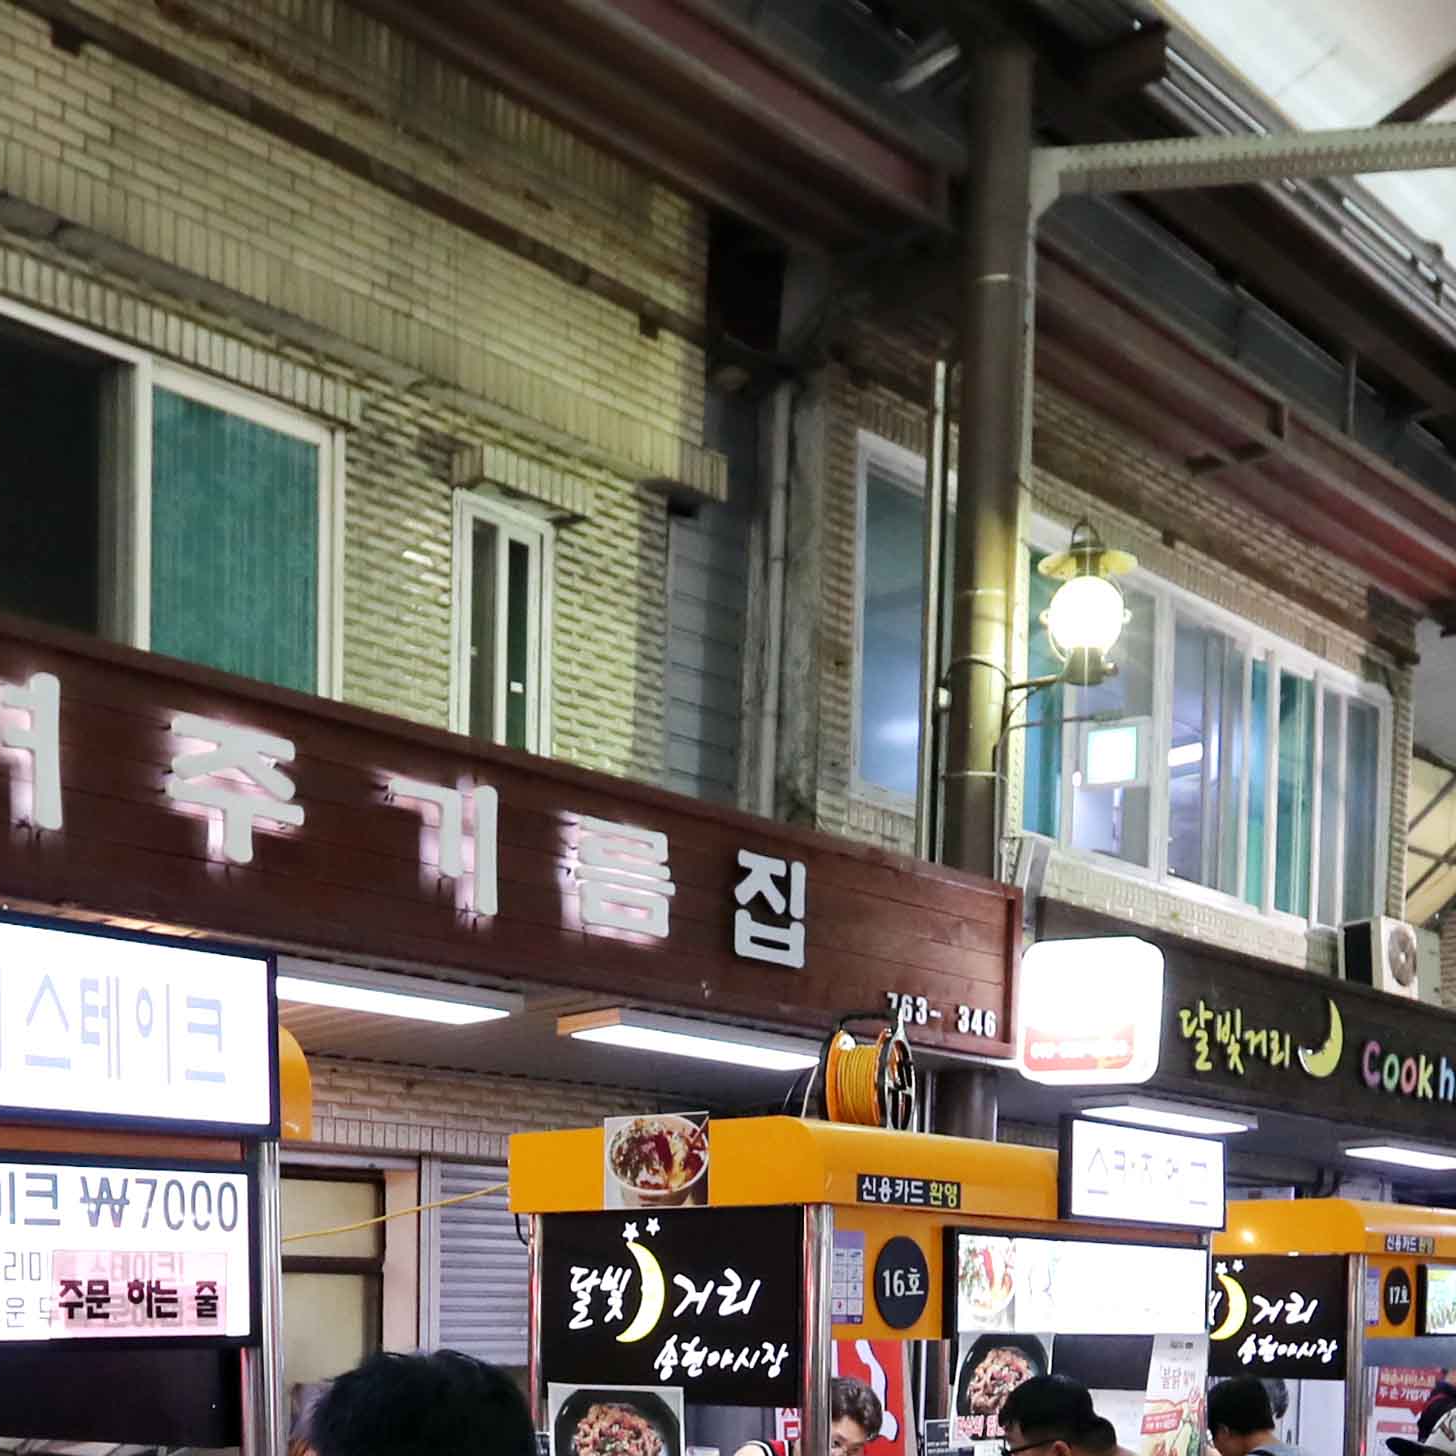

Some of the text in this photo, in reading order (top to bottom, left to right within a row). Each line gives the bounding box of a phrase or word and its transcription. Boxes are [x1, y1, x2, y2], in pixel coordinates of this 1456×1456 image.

[1179, 999, 1291, 1075] 달빛거리
[1362, 1040, 1433, 1099] Cook
[861, 1176, 959, 1209] 신용카드 환영
[58, 1279, 111, 1320] 주문
[126, 1278, 178, 1319] 하는
[194, 1280, 220, 1318] 줄
[569, 1266, 761, 1329] 달빛 거리
[882, 1268, 924, 1298] 16호
[1252, 1291, 1319, 1324] 거리
[654, 1335, 789, 1381] 송현야시장
